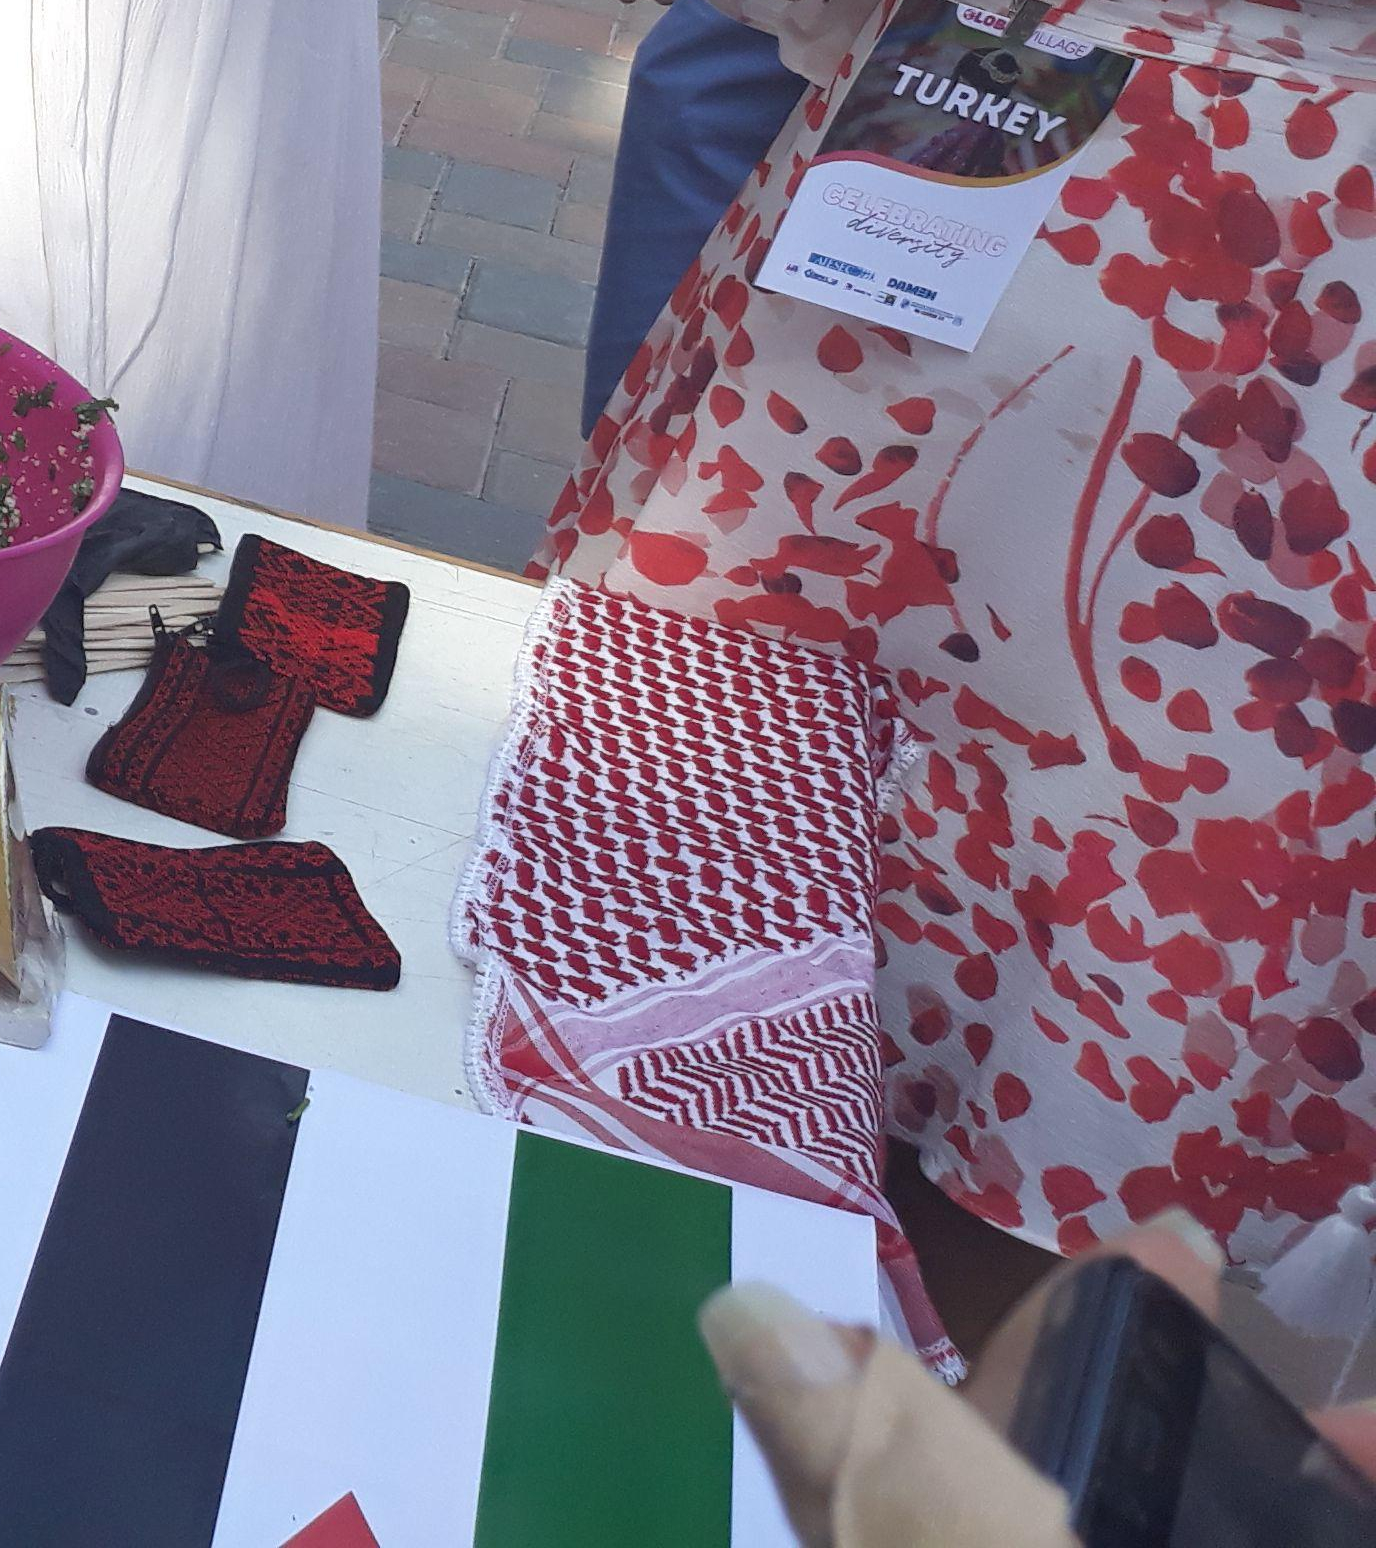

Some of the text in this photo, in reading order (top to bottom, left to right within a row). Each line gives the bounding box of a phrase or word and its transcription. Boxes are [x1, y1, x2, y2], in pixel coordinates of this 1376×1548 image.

[963, 8, 1089, 58] GLOB ILLAGE
[892, 63, 1068, 144] TURKEY
[821, 180, 1010, 258] CELEBRATING
[846, 211, 970, 270] diversity
